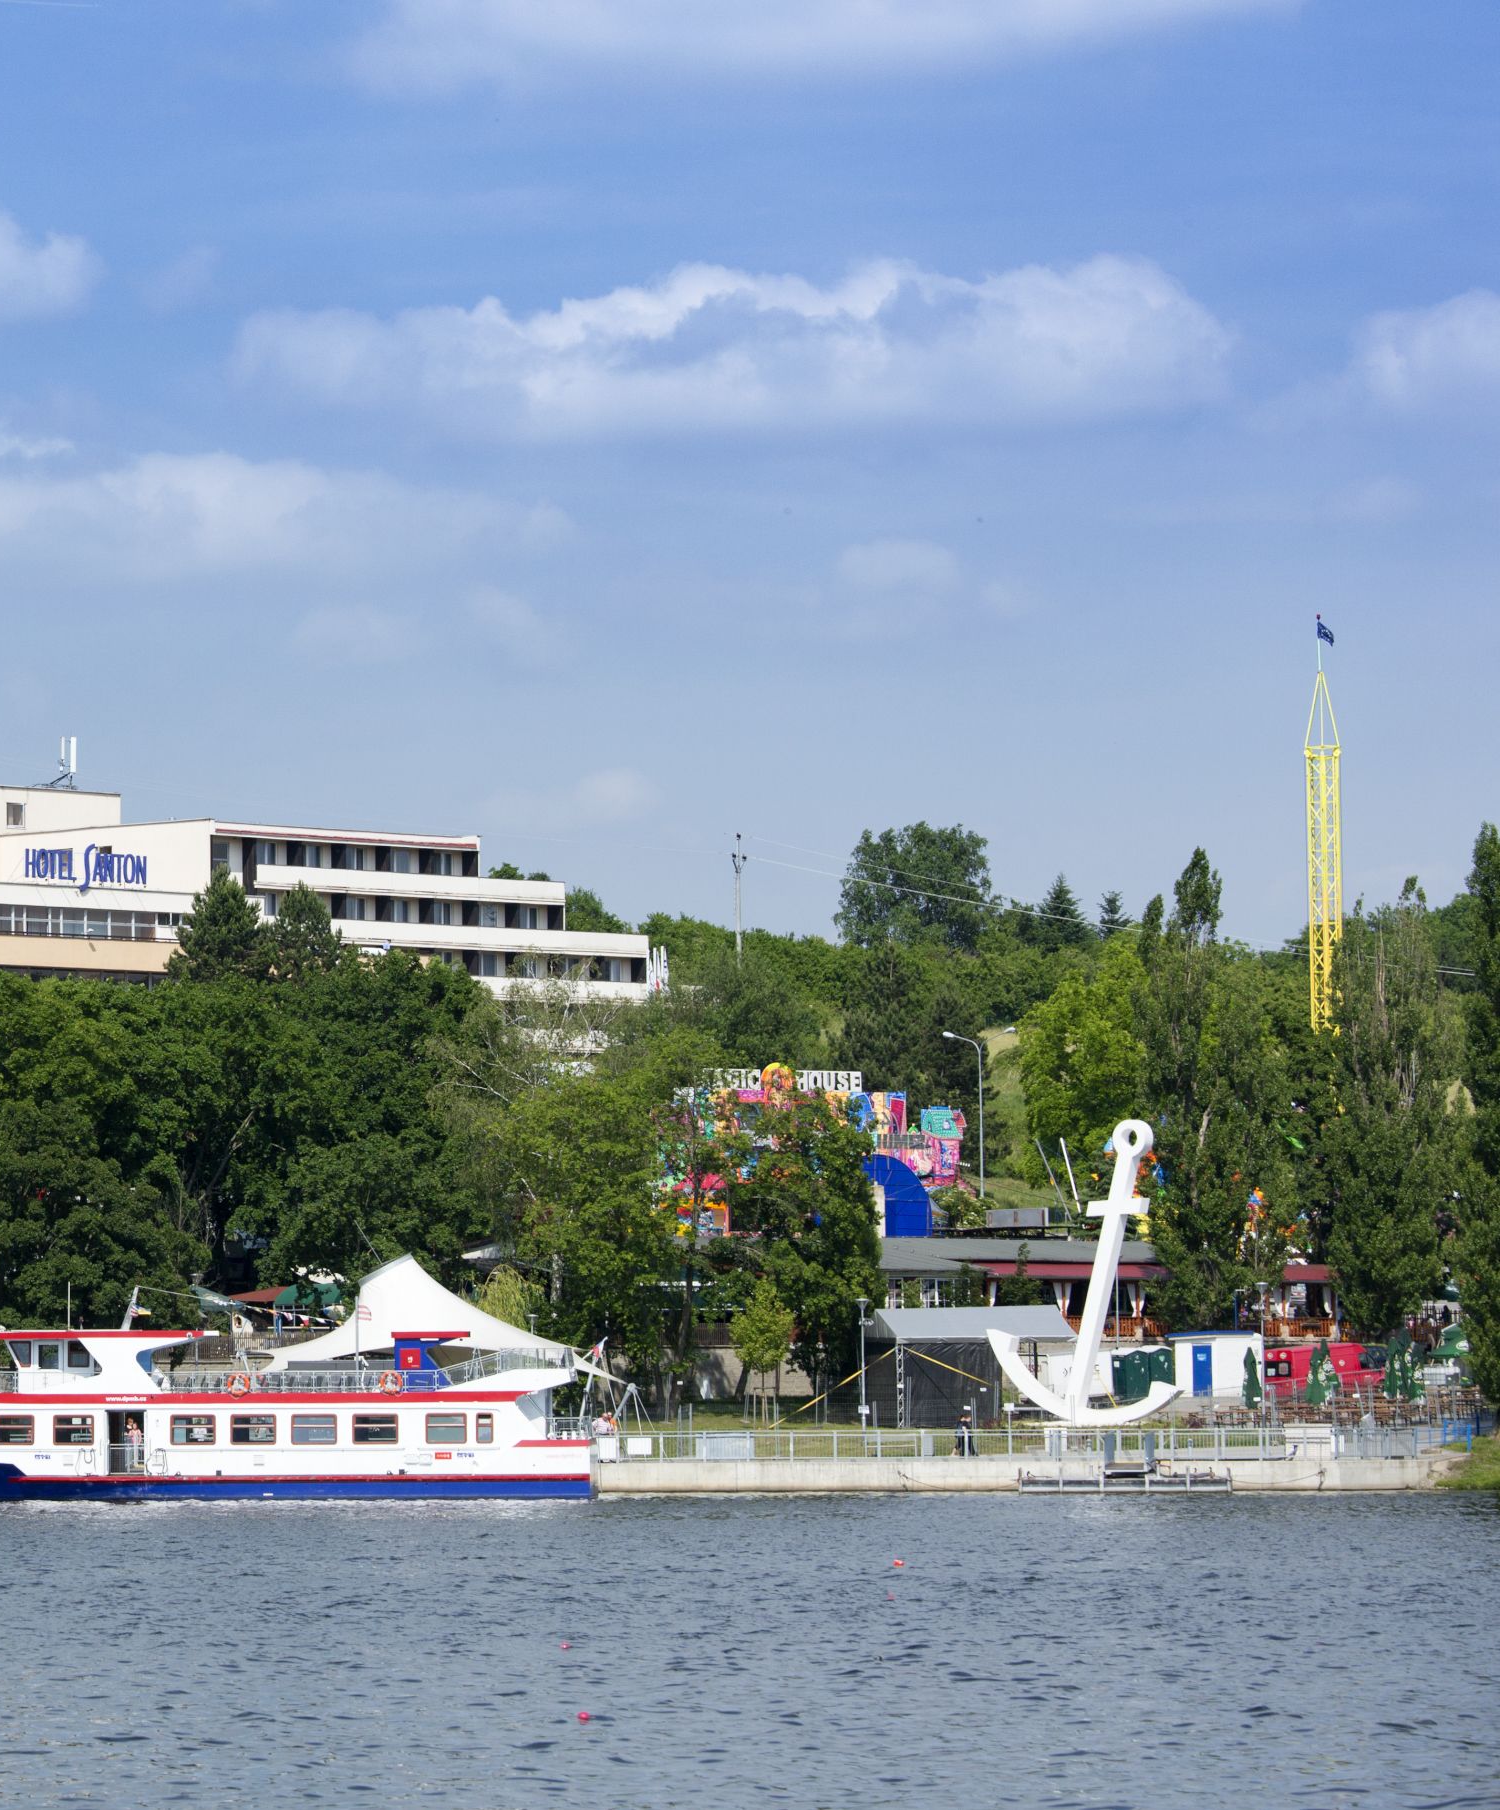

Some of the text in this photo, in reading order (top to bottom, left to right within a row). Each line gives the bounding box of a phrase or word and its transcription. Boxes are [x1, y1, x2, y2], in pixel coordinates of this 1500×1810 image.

[25, 843, 147, 892] HOTEL SANTON
[796, 1071, 861, 1091] HOUSE
